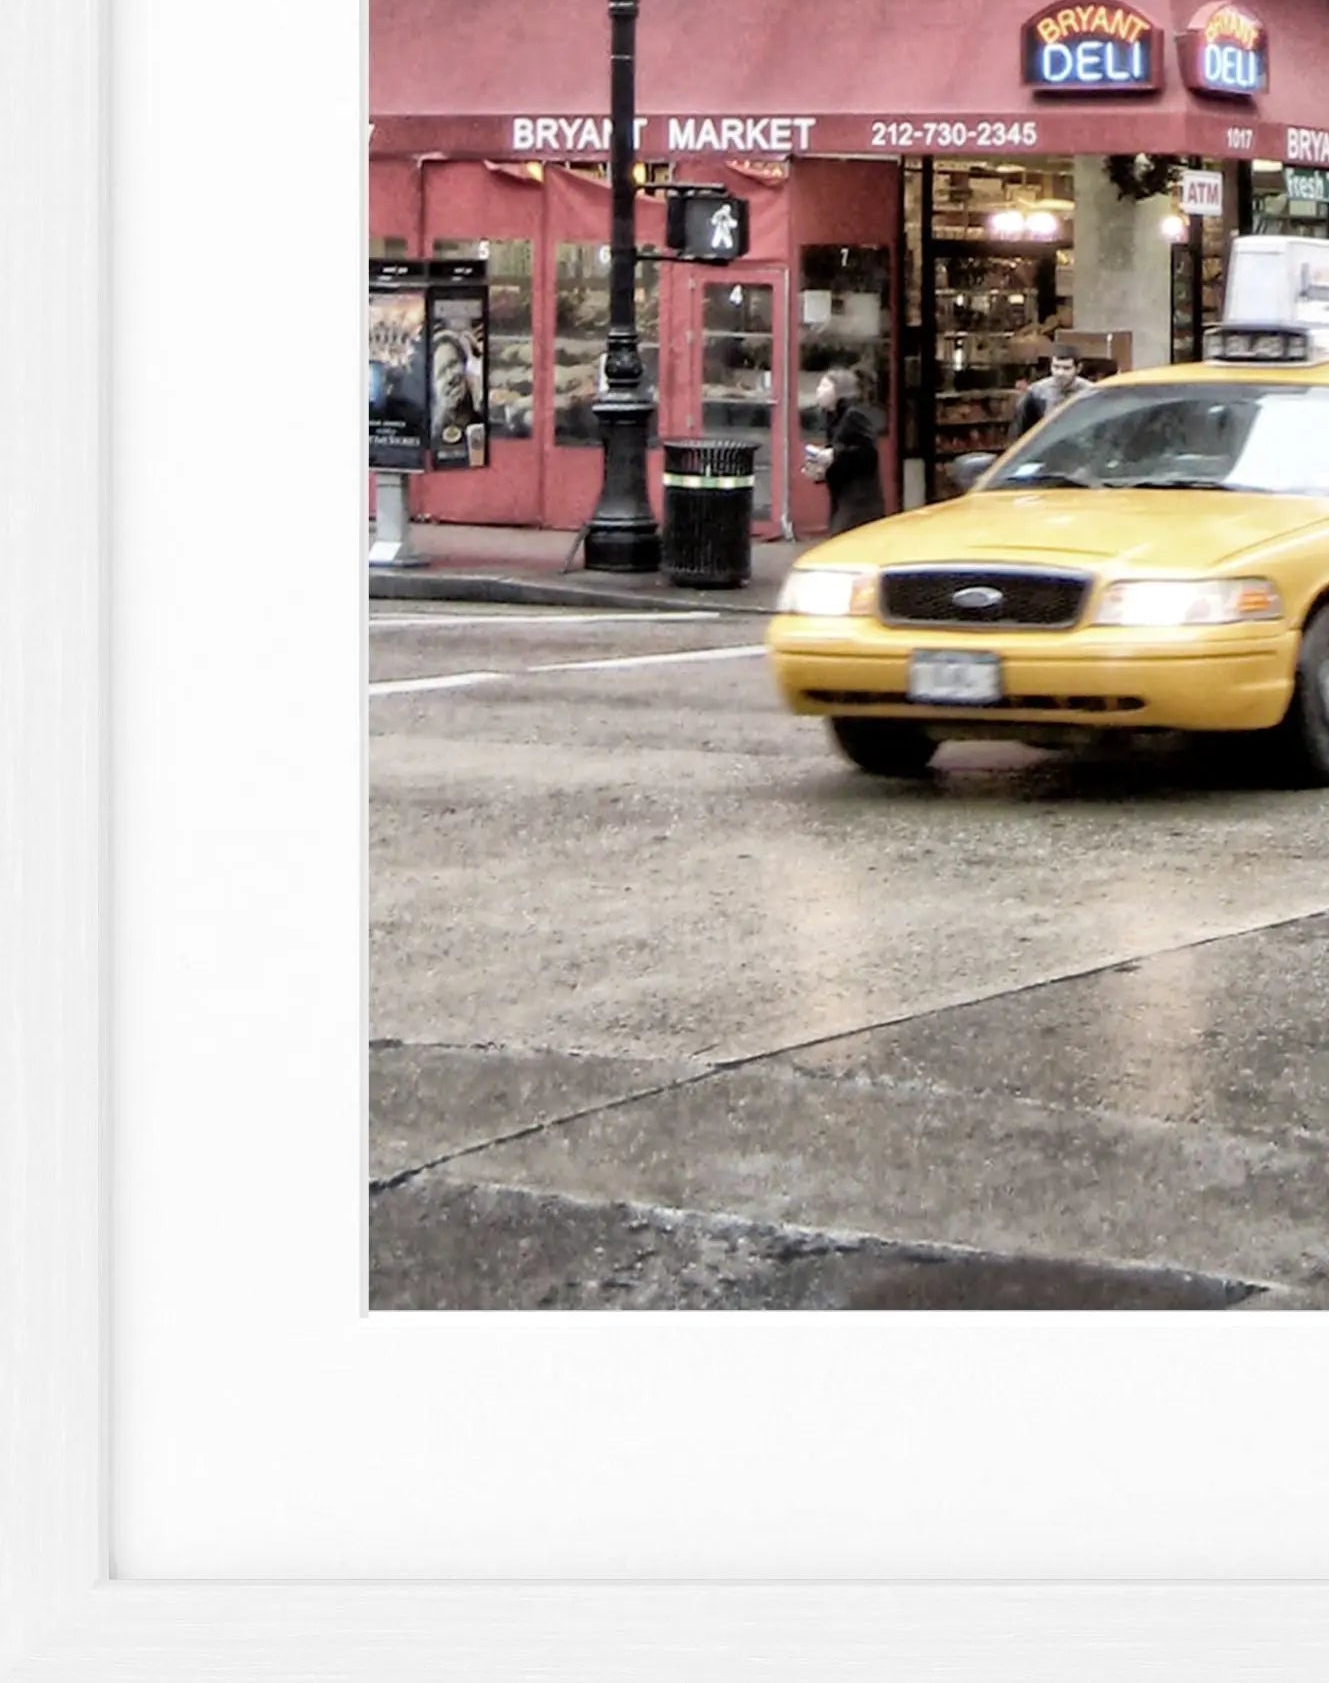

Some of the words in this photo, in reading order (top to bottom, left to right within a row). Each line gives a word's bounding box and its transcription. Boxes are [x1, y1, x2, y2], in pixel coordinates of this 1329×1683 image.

[1037, 4, 1151, 44] BRYANT
[1042, 40, 1142, 83] DELI
[1204, 43, 1256, 86] DELI
[668, 118, 816, 150] MARKET
[871, 123, 1037, 147] 212-730-2345
[1226, 127, 1254, 150] 1017
[1187, 181, 1220, 204] ATM
[1285, 167, 1324, 199] Fresh
[478, 240, 490, 260] 5
[599, 245, 611, 264] 6
[729, 284, 743, 305] 4
